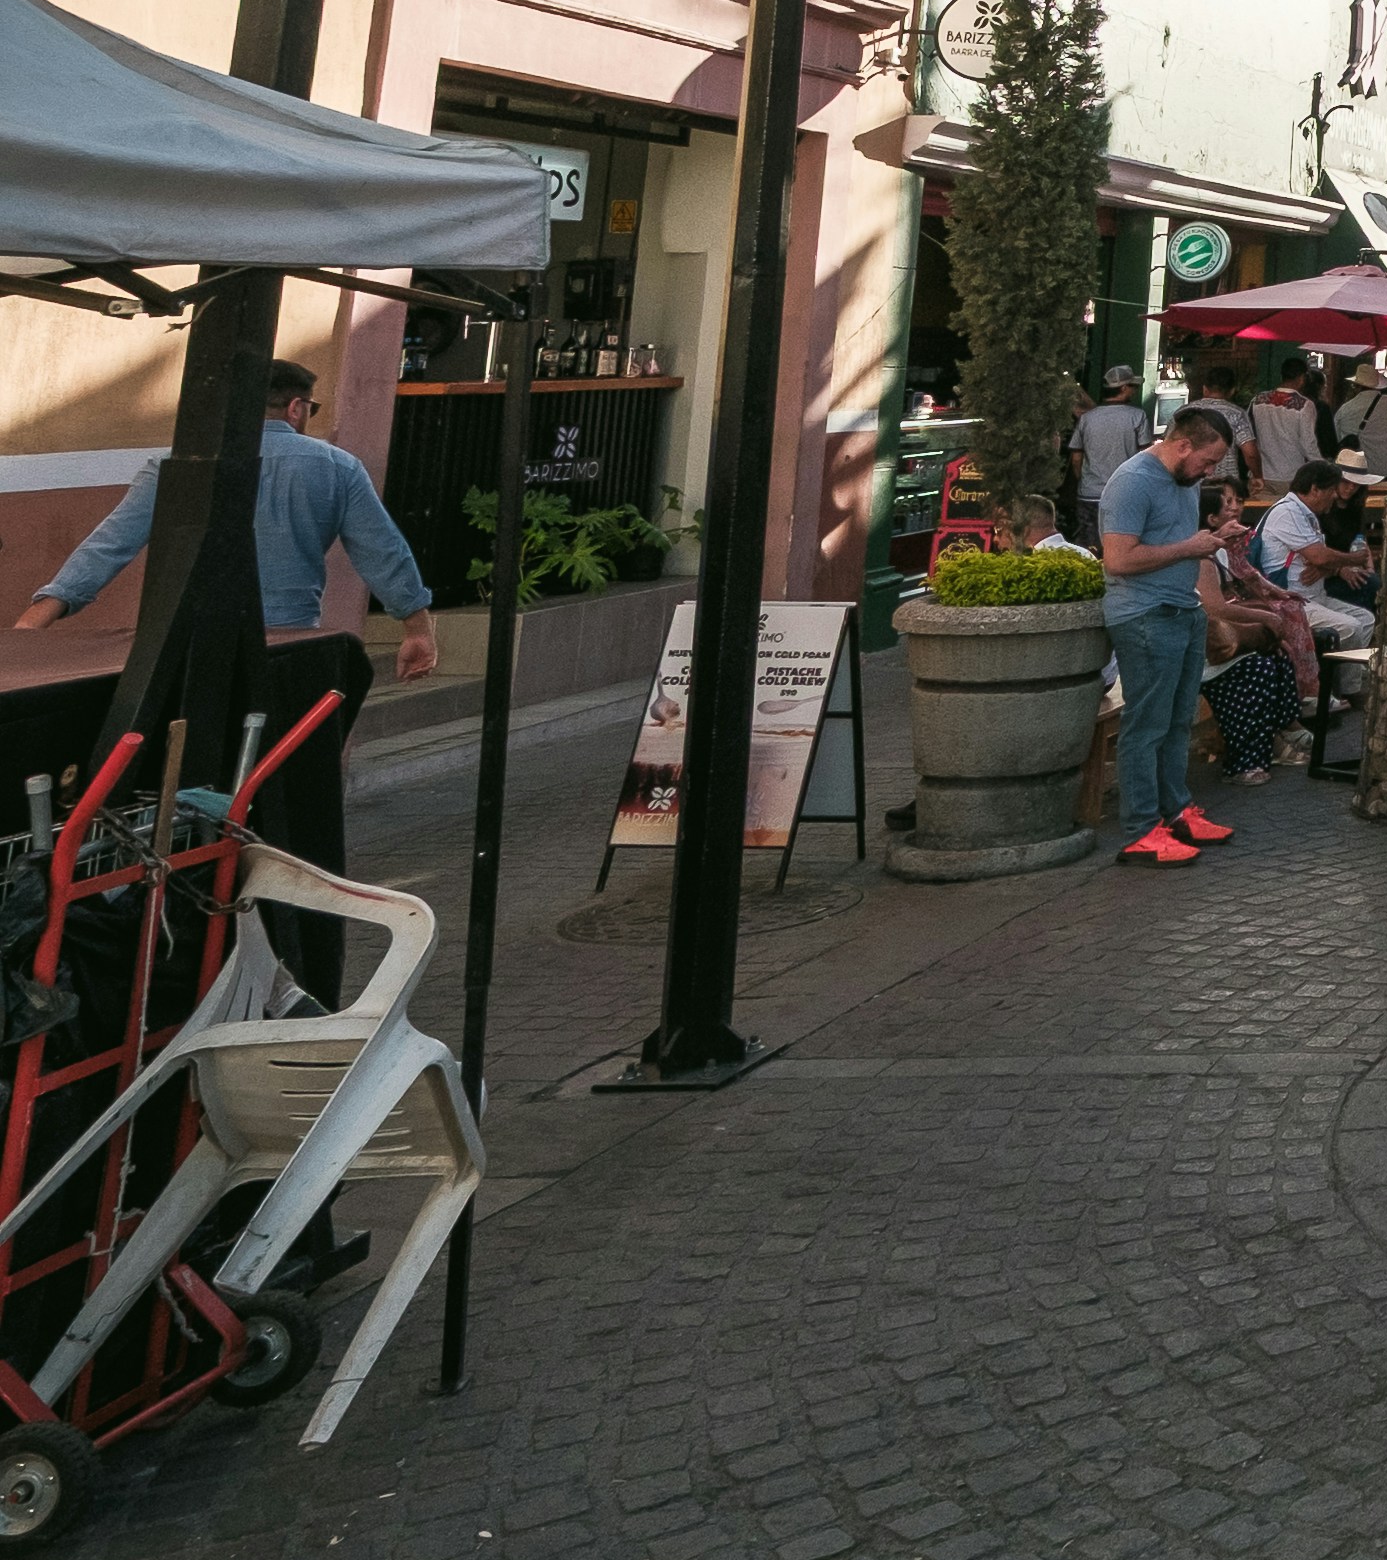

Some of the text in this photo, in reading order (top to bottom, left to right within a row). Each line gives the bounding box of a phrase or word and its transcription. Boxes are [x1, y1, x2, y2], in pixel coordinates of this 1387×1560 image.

[950, 47, 993, 58] BARRA DE
[774, 651, 800, 659] COLD
[802, 651, 831, 659] FOAM
[766, 666, 822, 677] PISTACHE
[757, 676, 827, 686] COLD BREW
